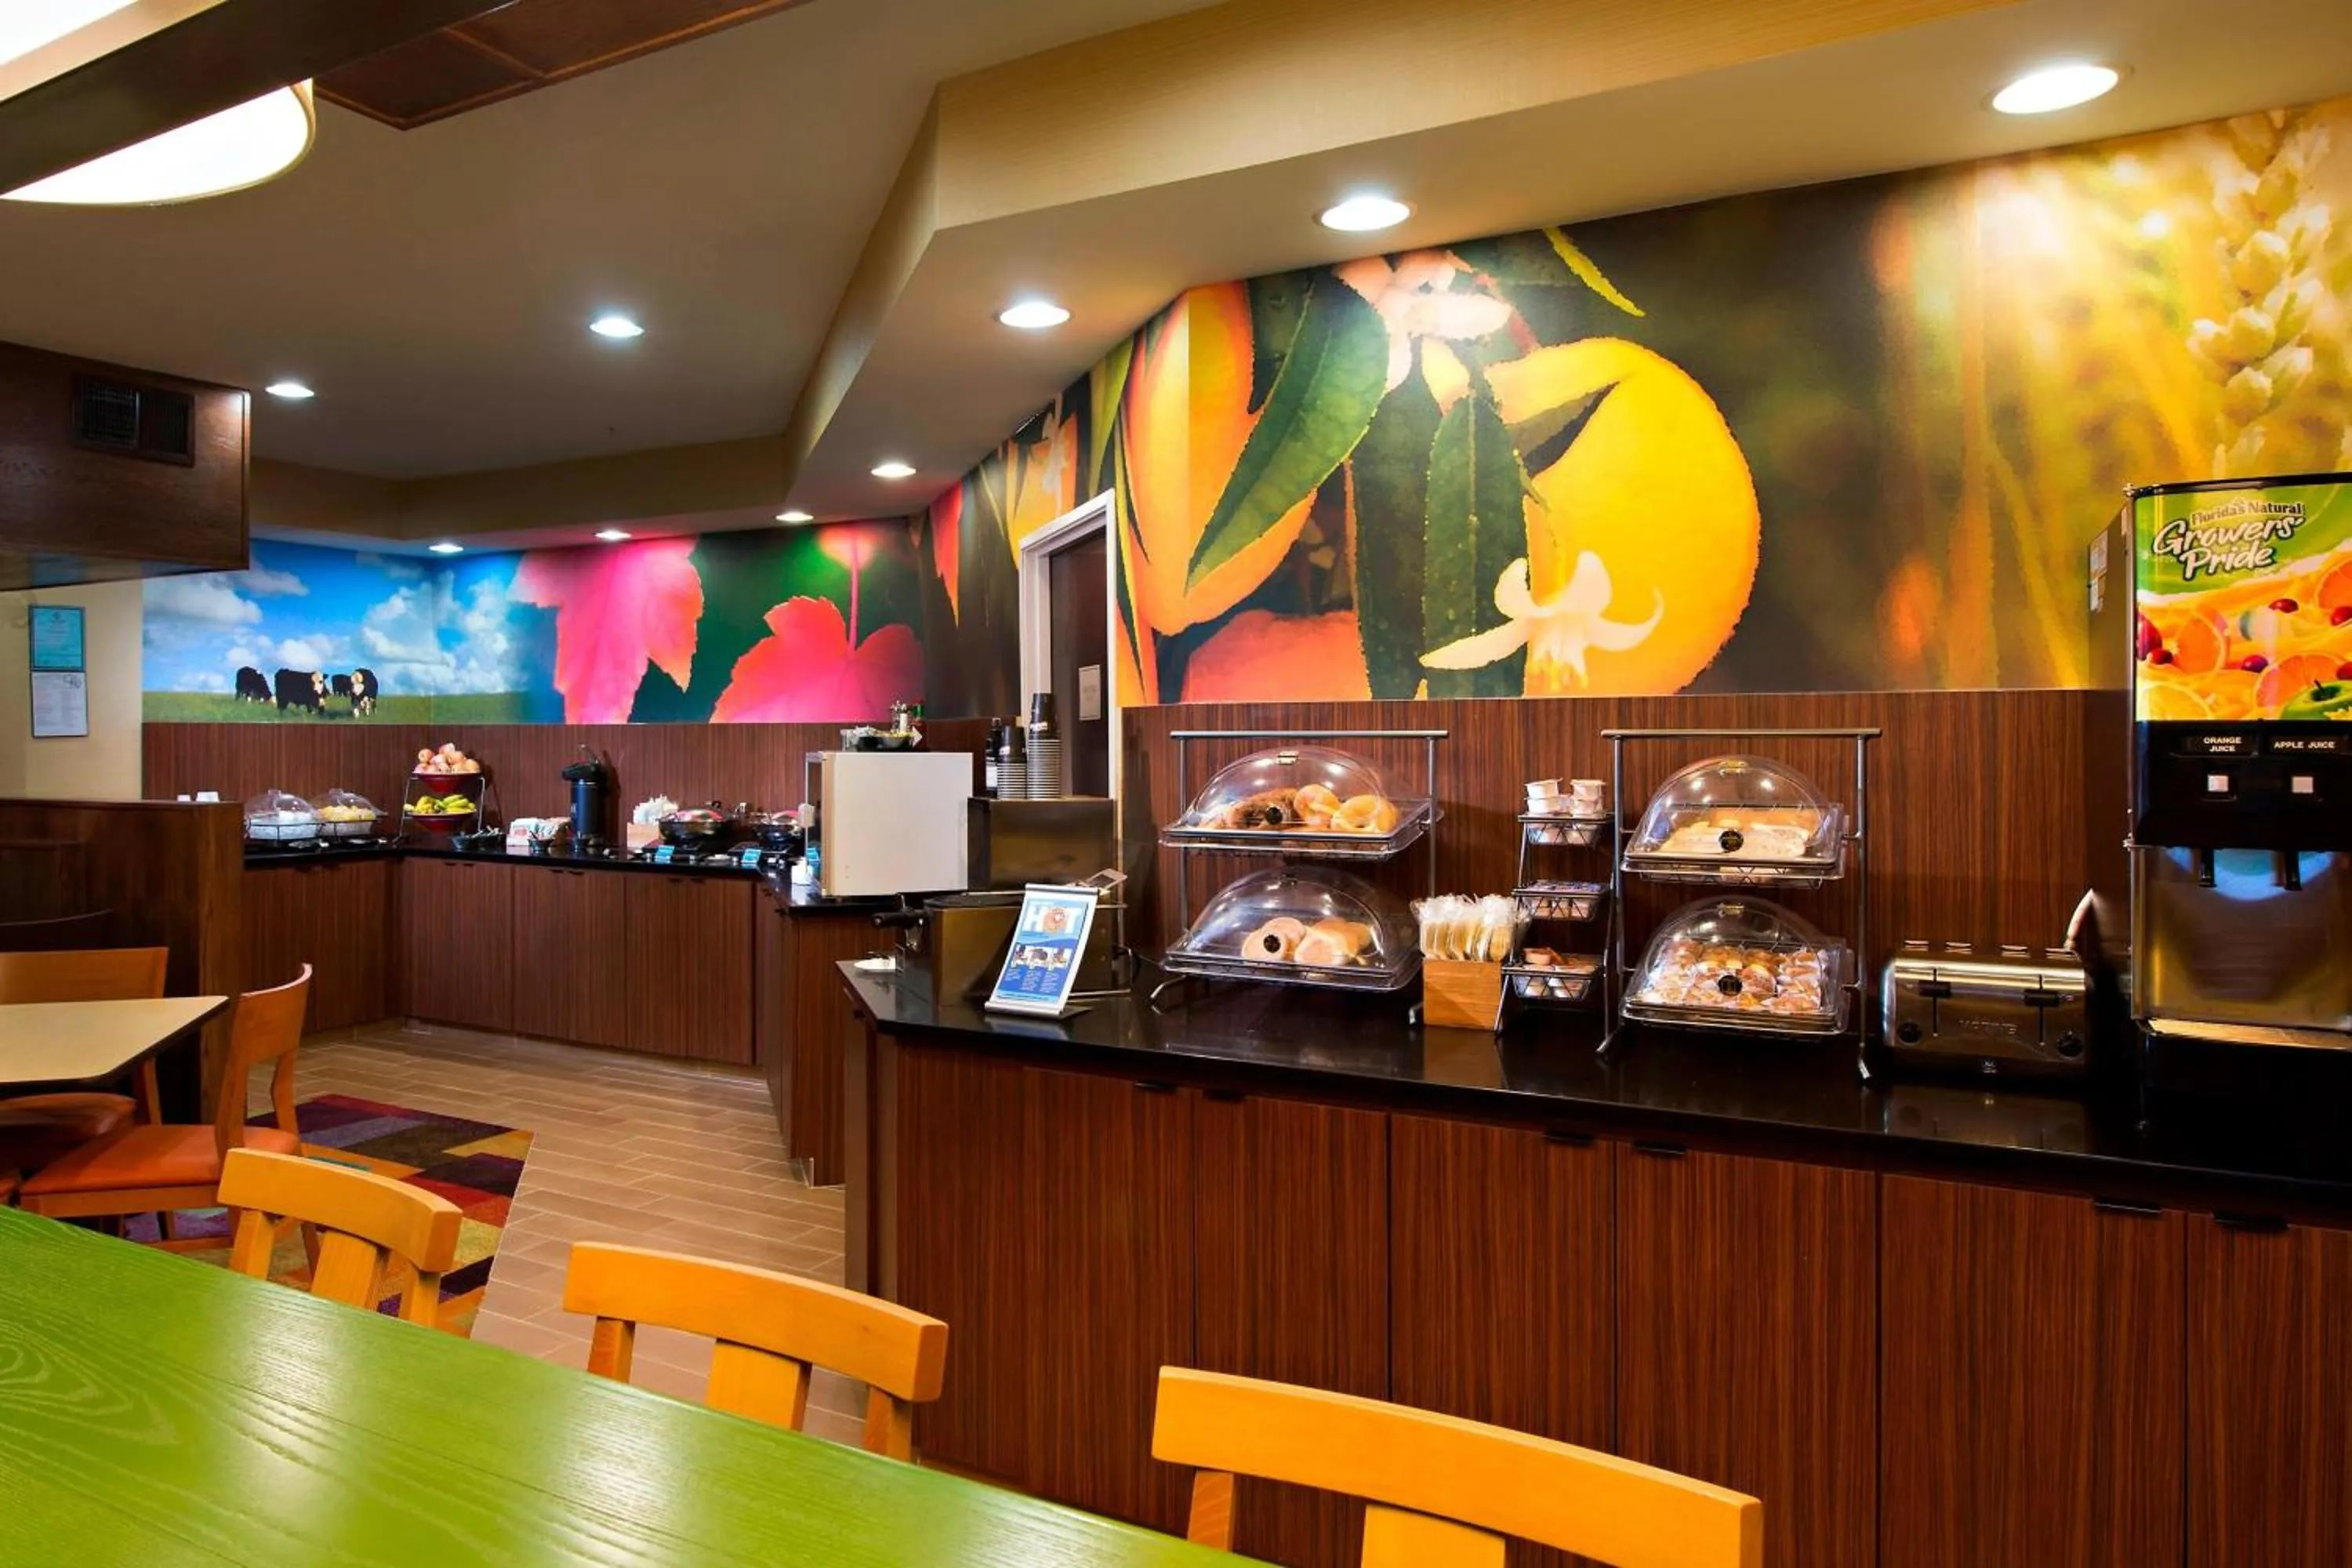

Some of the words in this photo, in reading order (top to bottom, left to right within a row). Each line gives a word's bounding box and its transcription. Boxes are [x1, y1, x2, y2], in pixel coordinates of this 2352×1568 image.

[2191, 504, 2247, 525] Florida's
[2248, 502, 2302, 515] Natural
[2179, 539, 2274, 580] Pride
